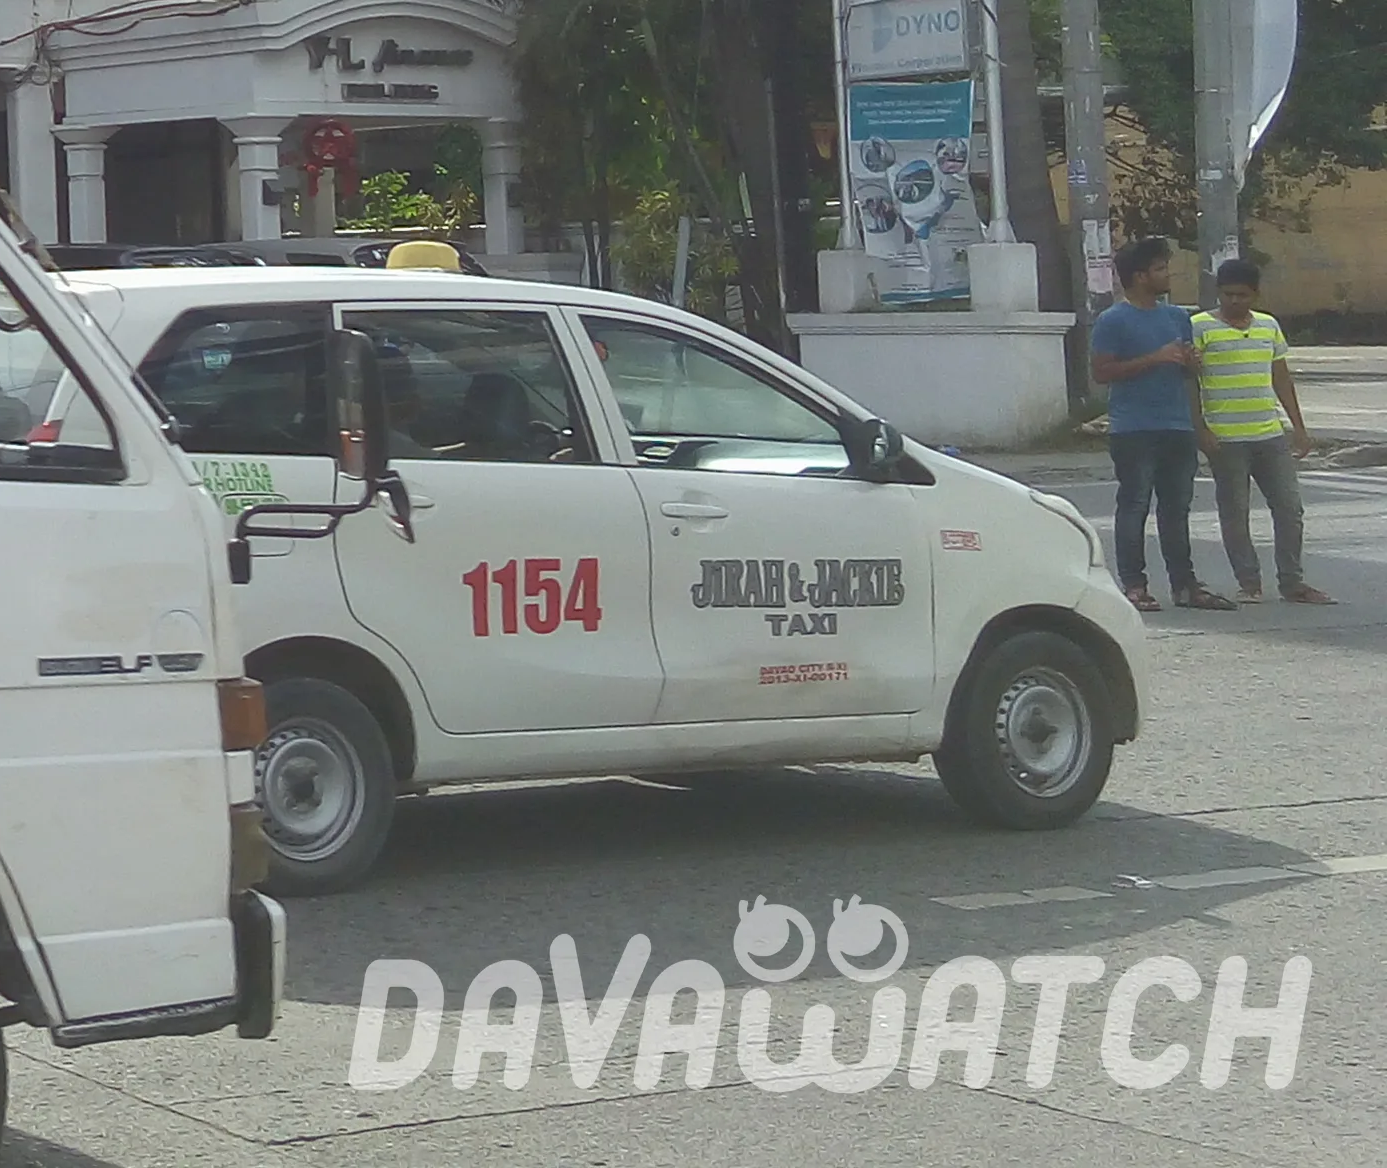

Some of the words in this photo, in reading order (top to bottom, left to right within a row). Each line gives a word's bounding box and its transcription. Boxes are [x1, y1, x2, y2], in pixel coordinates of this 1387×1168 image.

[895, 9, 961, 37] DYNO
[462, 557, 602, 637] 1154
[808, 558, 905, 608] JACKIE
[765, 613, 838, 637] TAXI
